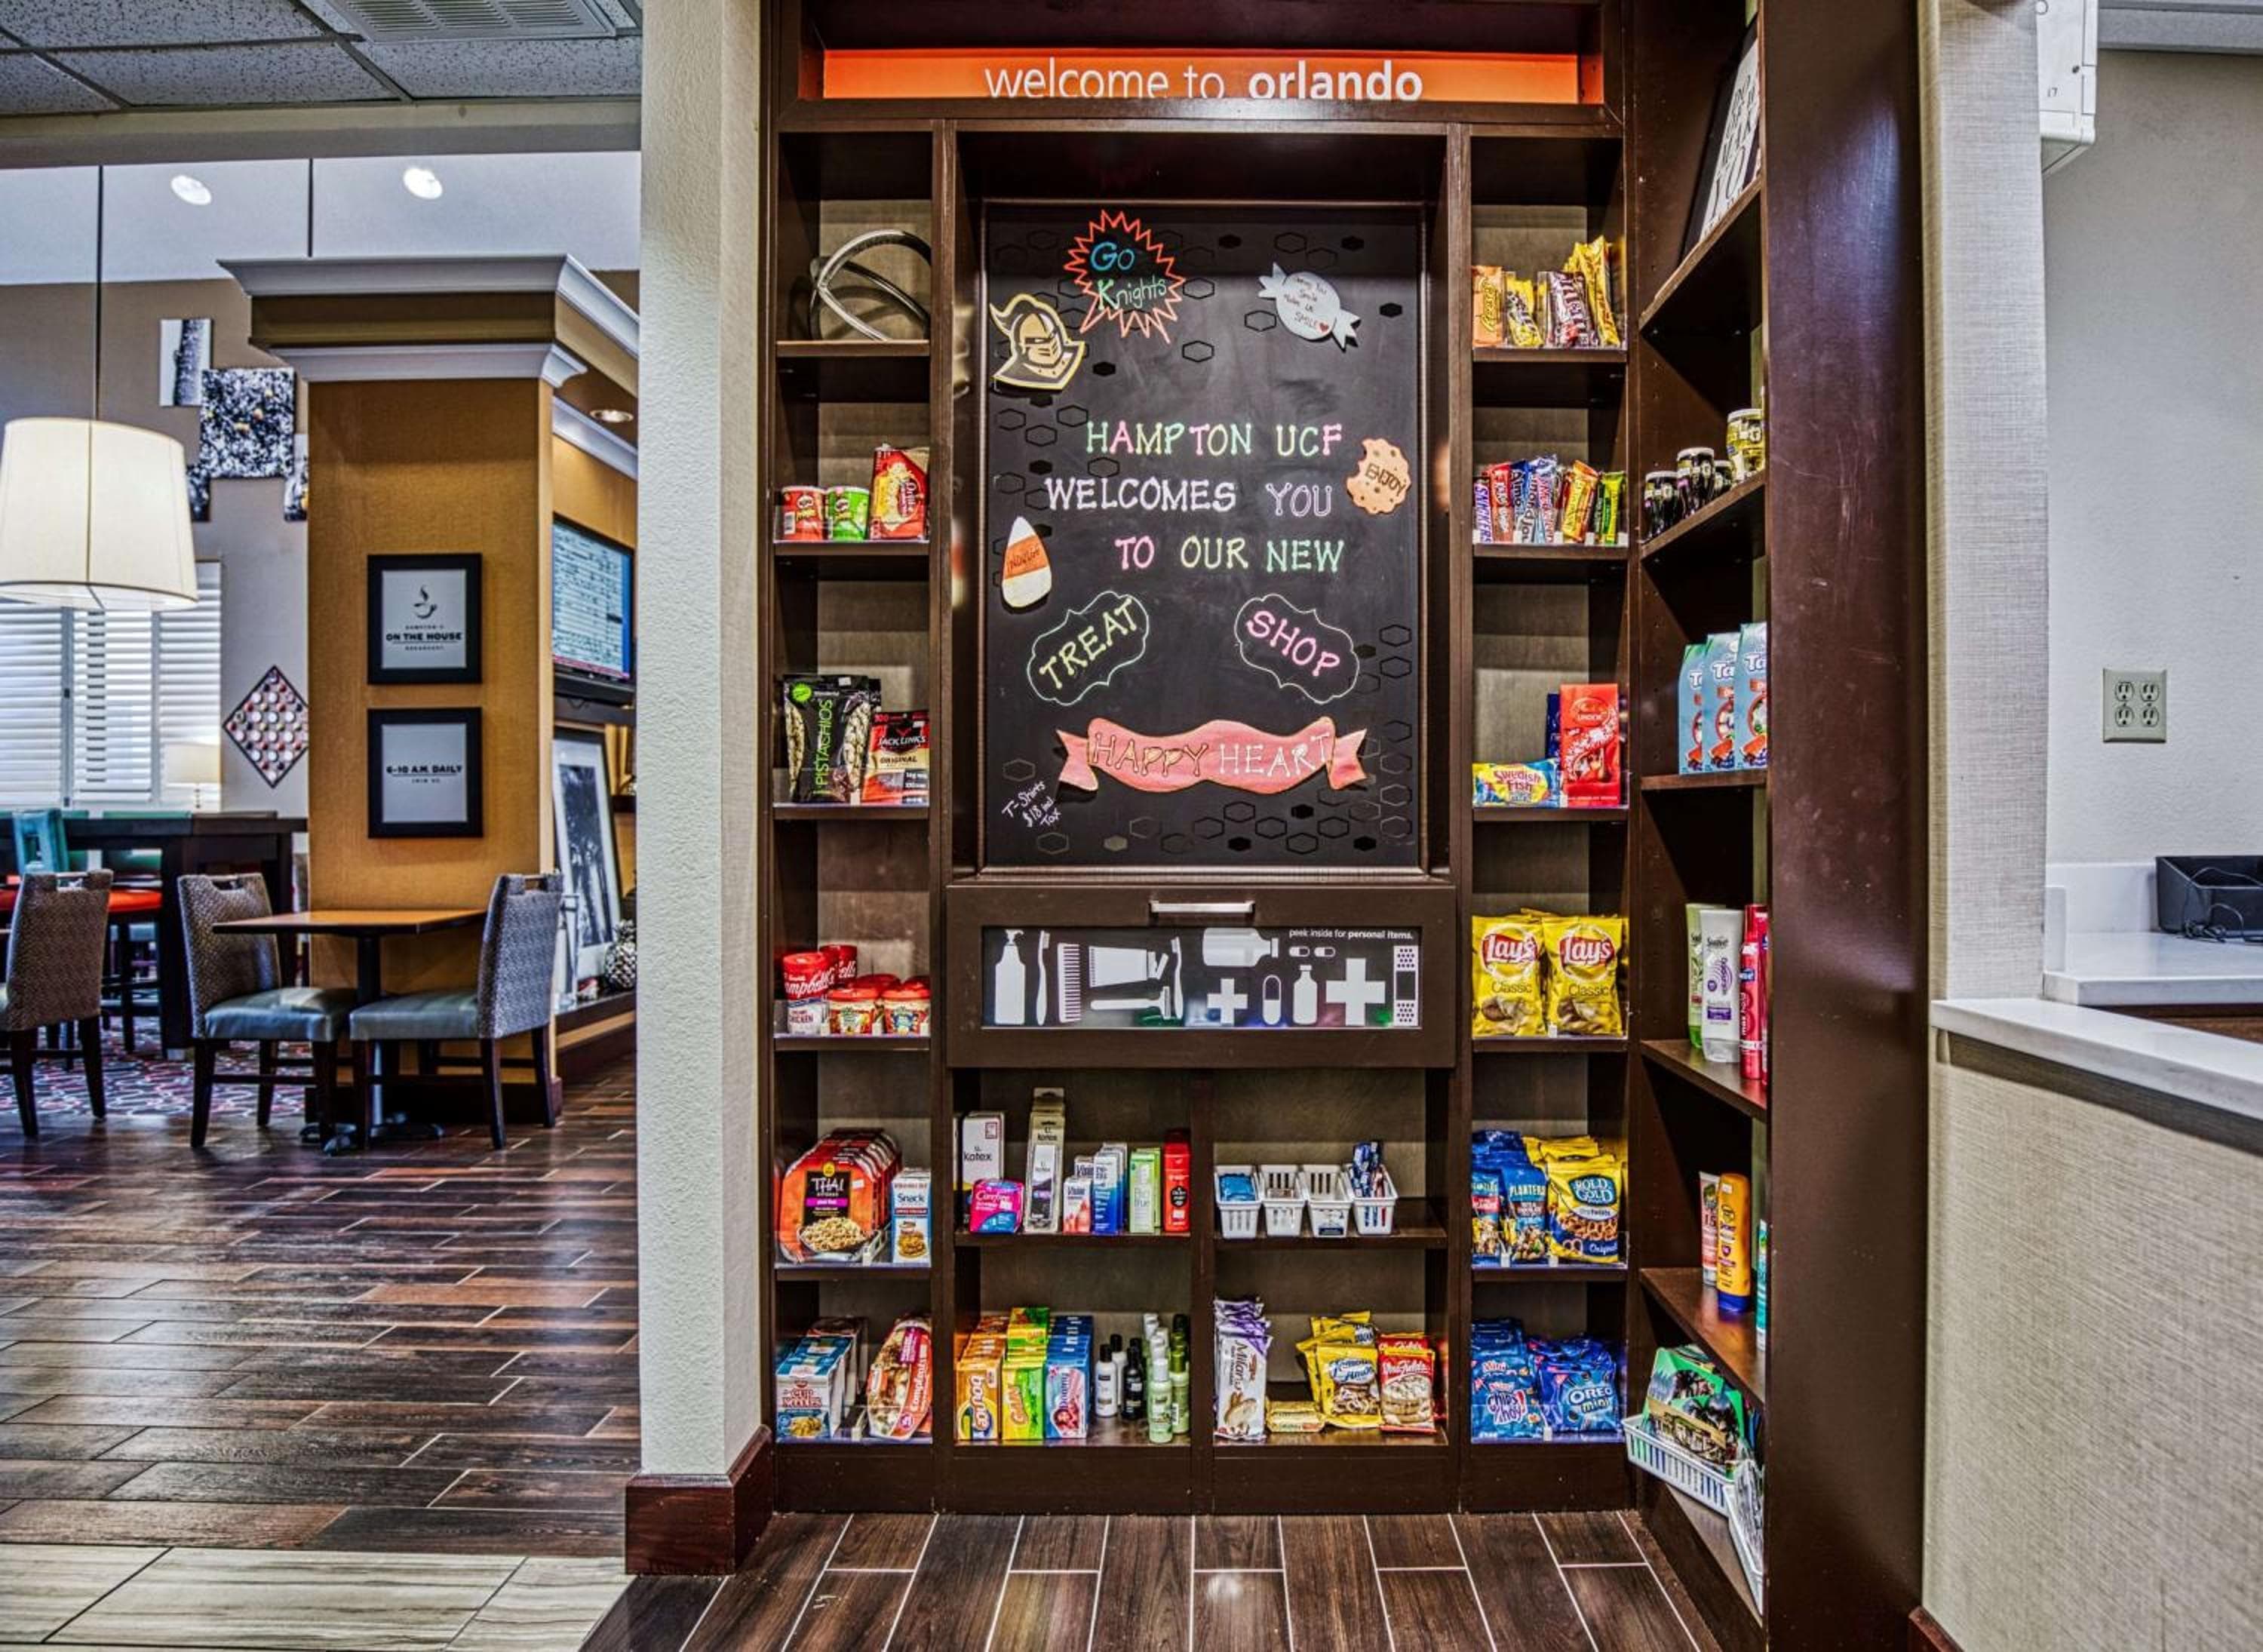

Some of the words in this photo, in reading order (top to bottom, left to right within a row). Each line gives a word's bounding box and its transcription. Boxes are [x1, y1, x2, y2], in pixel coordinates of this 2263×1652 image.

[985, 56, 1169, 99] welcome
[1184, 64, 1225, 99] to
[1248, 60, 1423, 101] orlando
[1090, 242, 1135, 270] Go
[1097, 278, 1168, 311] Knights
[1086, 420, 1252, 456] HAMPTON
[1276, 423, 1343, 456] UCF
[1364, 461, 1408, 499] ENJOY
[1045, 476, 1236, 512] WELCOMES
[1266, 482, 1333, 517] YOU
[1115, 535, 1155, 570] TO
[1180, 535, 1248, 570] OUR
[1266, 539, 1344, 573] NEW
[385, 632, 401, 642] ON
[404, 631, 423, 641] THE
[426, 631, 462, 641] HOUSE
[1039, 597, 1139, 689] TREAT
[1245, 610, 1341, 677] SHOP
[815, 699, 834, 785] PISTACHIOS
[1089, 732, 1209, 777] HAPPY
[1218, 732, 1331, 776] HEART
[431, 764, 462, 774] DAILY
[1493, 769, 1541, 783] Swedish
[1506, 779, 1533, 792] Fish
[1288, 929, 1309, 938] peek
[1310, 929, 1333, 938] inside
[1334, 929, 1346, 938] for
[1347, 929, 1386, 940] personal
[1491, 981, 1533, 993] Classic
[1568, 983, 1610, 996] Classic
[811, 1177, 845, 1193] THAI
[1576, 1187, 1616, 1202] GOLD
[969, 1374, 991, 1432] bounce
[1568, 1386, 1613, 1405] OREO
[1580, 1399, 1611, 1414] mini
